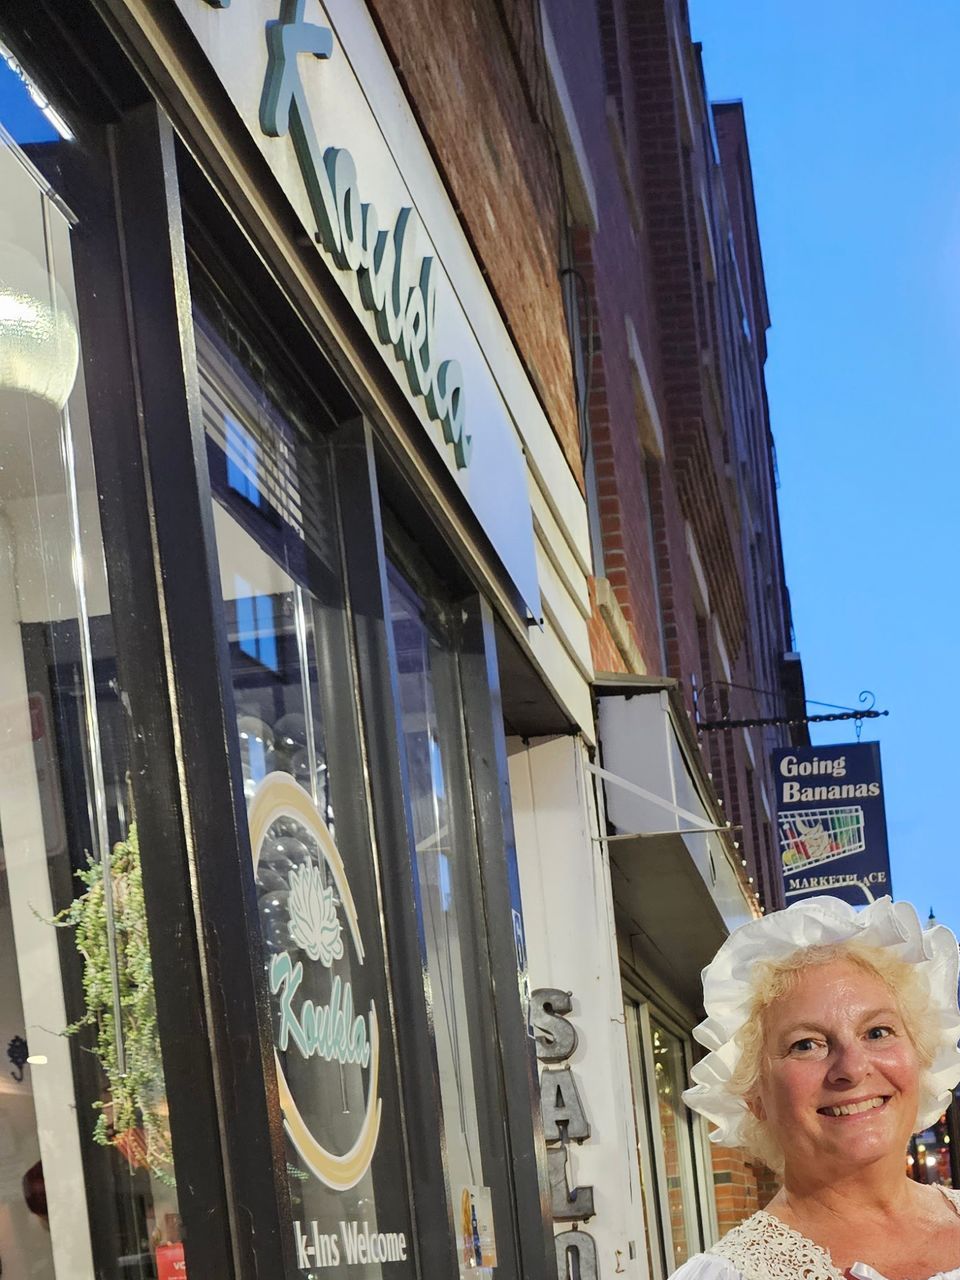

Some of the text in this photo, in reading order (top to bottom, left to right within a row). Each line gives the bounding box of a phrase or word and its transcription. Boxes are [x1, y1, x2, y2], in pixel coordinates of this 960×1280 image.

[780, 755, 847, 777] Going
[782, 781, 881, 803] Bananas
[788, 871, 887, 890] MARKETPLACE
[269, 950, 371, 1069] Koukla
[339, 1220, 408, 1265] Welcome
